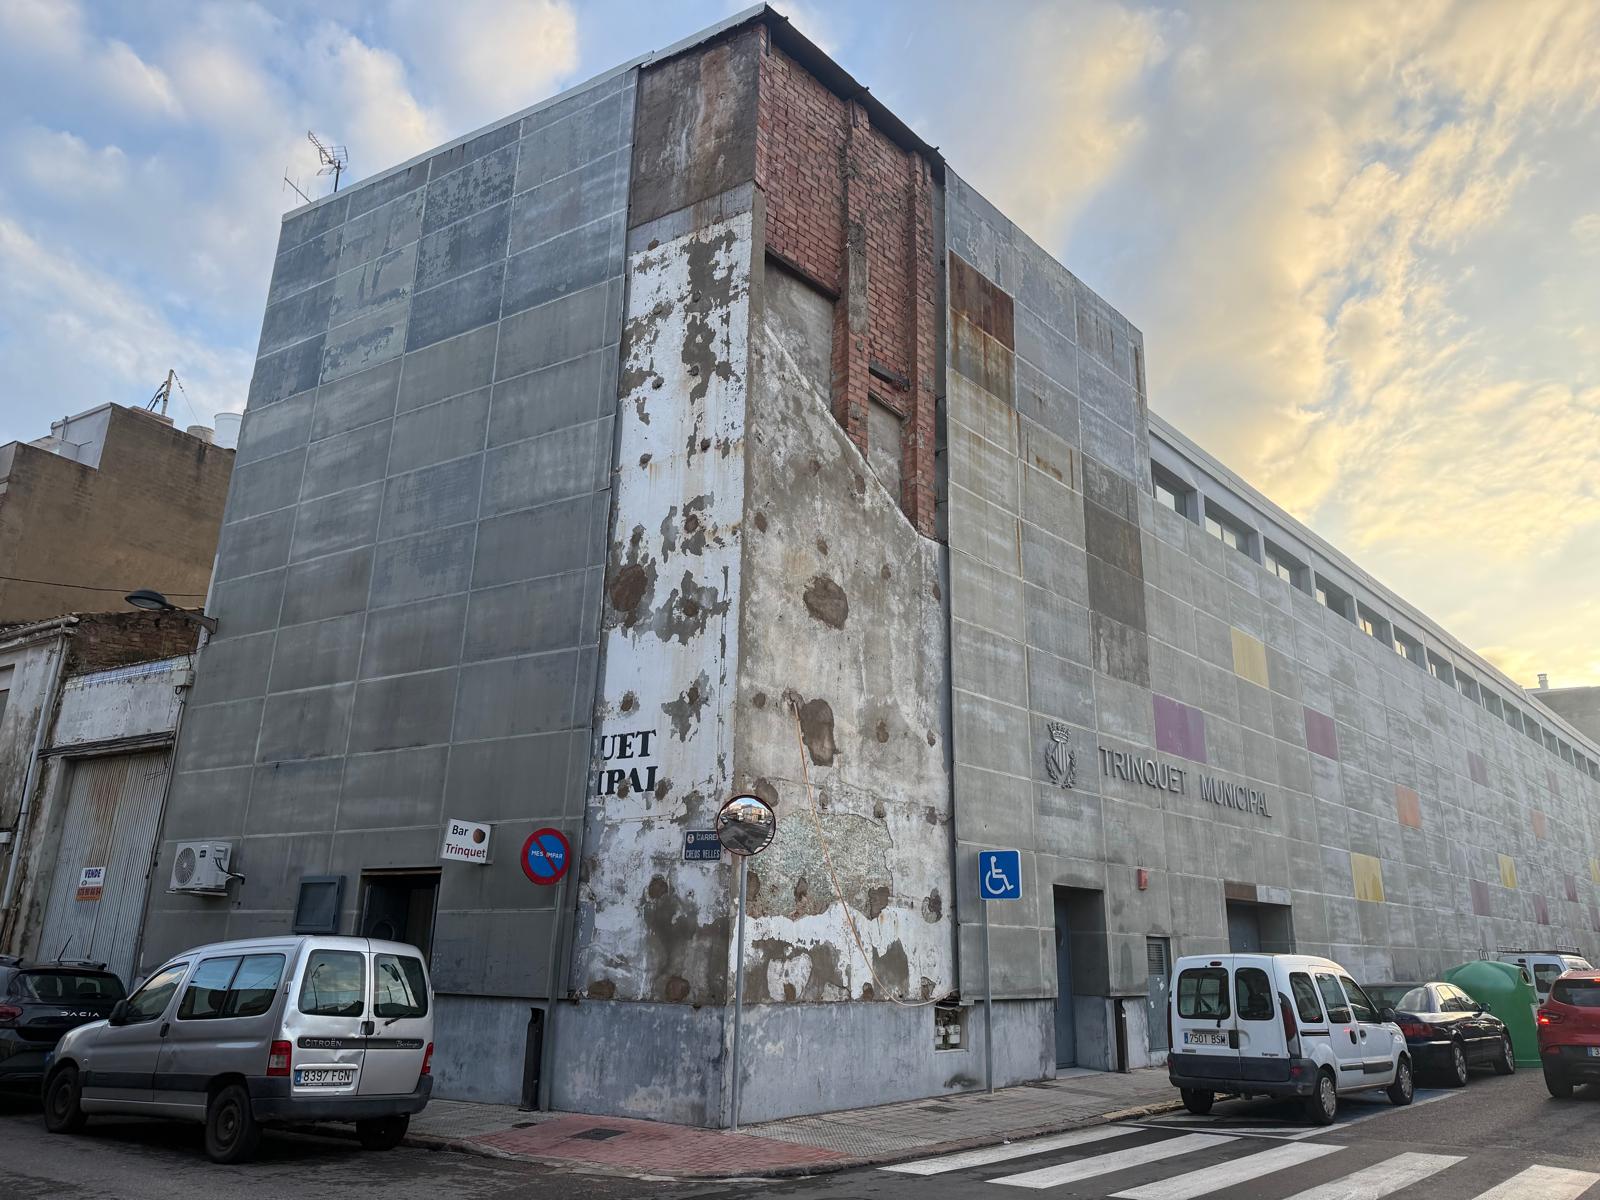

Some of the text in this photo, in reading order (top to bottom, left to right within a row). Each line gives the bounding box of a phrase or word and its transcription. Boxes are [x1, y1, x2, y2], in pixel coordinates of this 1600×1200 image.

[1099, 746, 1272, 817] TRINQUET MUNICIPAL
[452, 825, 469, 836] Bar
[446, 843, 486, 859] Trinquet
[85, 869, 102, 878] VENDE
[305, 1038, 343, 1047] CITROËN
[1190, 1033, 1207, 1043] 7501
[303, 1070, 350, 1082] 8397 FGN
